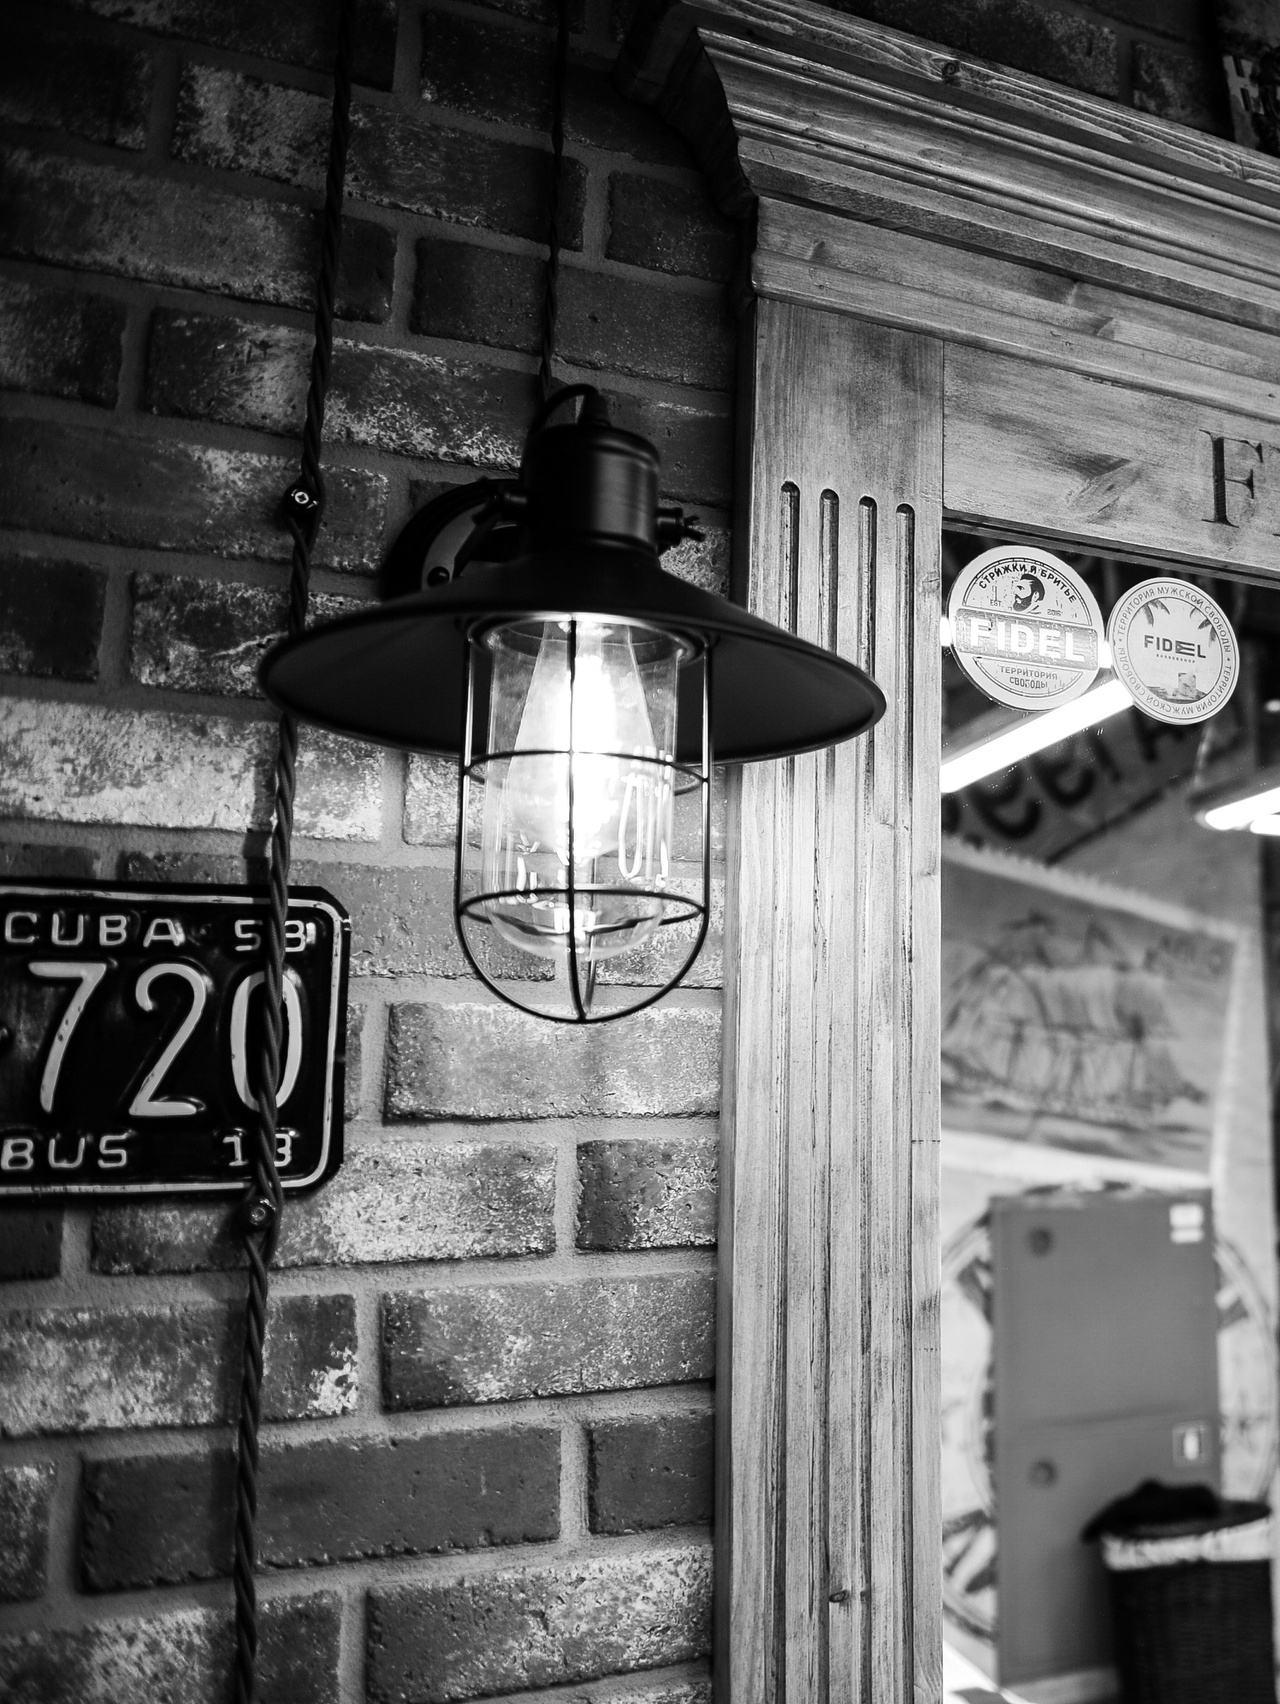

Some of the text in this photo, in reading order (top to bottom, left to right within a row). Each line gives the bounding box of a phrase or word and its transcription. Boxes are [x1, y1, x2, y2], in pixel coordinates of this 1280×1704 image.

[978, 563, 1028, 590] СТРИЖКИ
[1040, 568, 1077, 603] БРИТЬЕ
[969, 616, 1085, 663] FIDEL
[1117, 586, 1232, 653] ТЕРРИТОРИЯ МУЖСКОЙ СВОБОДЫ
[1144, 634, 1207, 659] FIDEL
[999, 665, 1058, 681] ТЕРРИТОРИЯ
[1119, 646, 1146, 697] СВОБОДЫ
[1195, 665, 1232, 713] ТЕРРИТОРИЯ
[5, 911, 184, 947] CUBA
[28, 961, 302, 1116] 720
[0, 1132, 292, 1170] BUS 13
